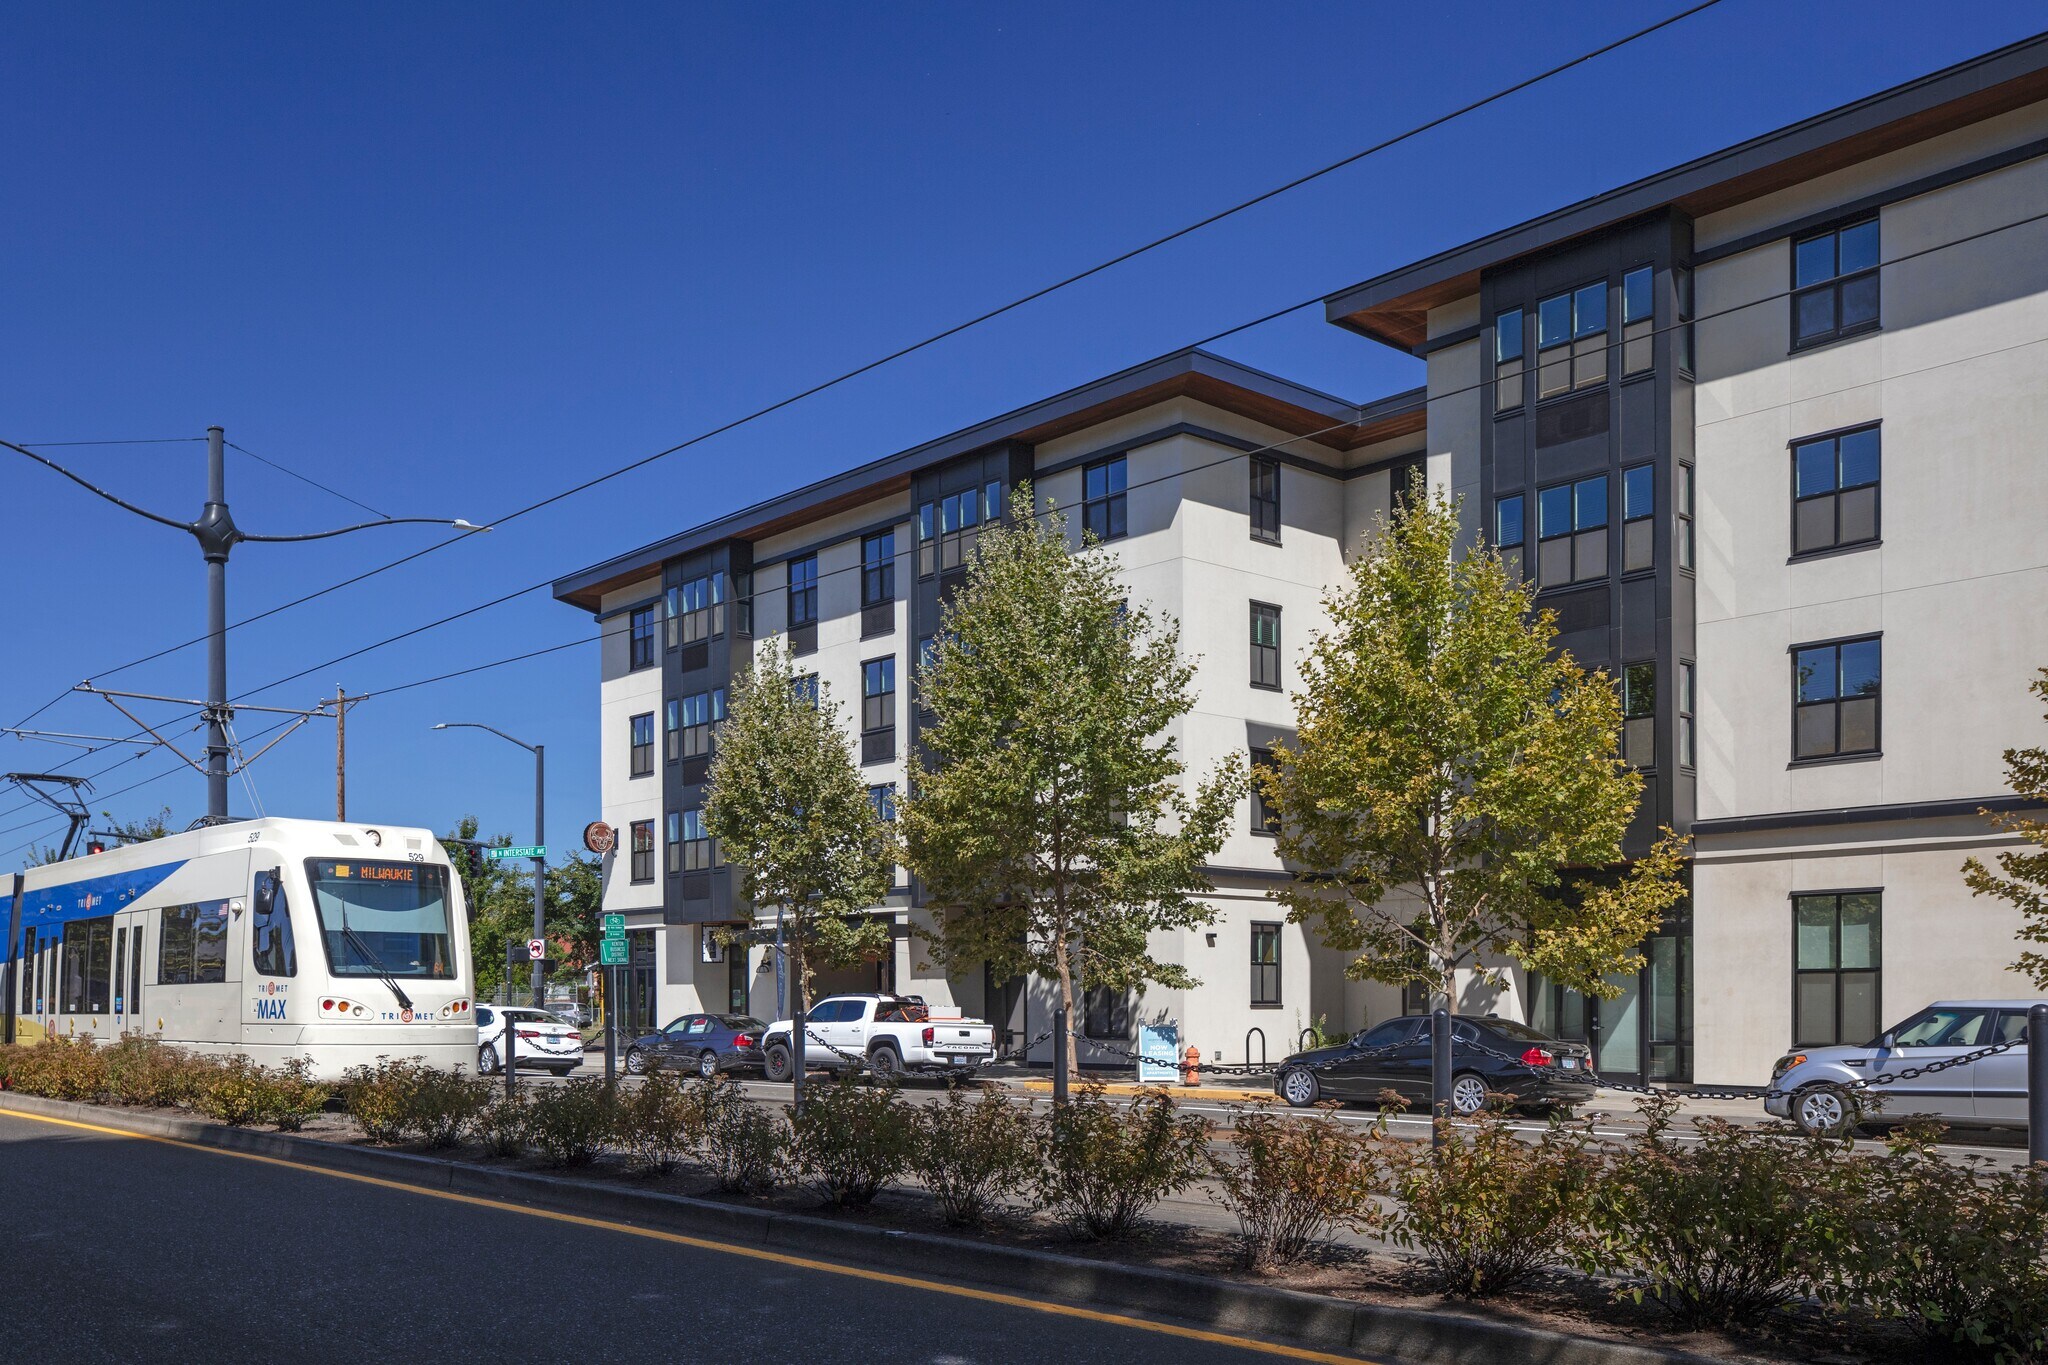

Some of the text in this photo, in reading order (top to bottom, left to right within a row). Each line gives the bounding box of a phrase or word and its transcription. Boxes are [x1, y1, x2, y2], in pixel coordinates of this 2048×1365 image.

[408, 852, 425, 863] 529
[503, 847, 535, 857] INTERSTATE
[536, 847, 546, 855] AVE
[360, 866, 414, 881] MILWAUKIE
[257, 999, 287, 1020] MAX
